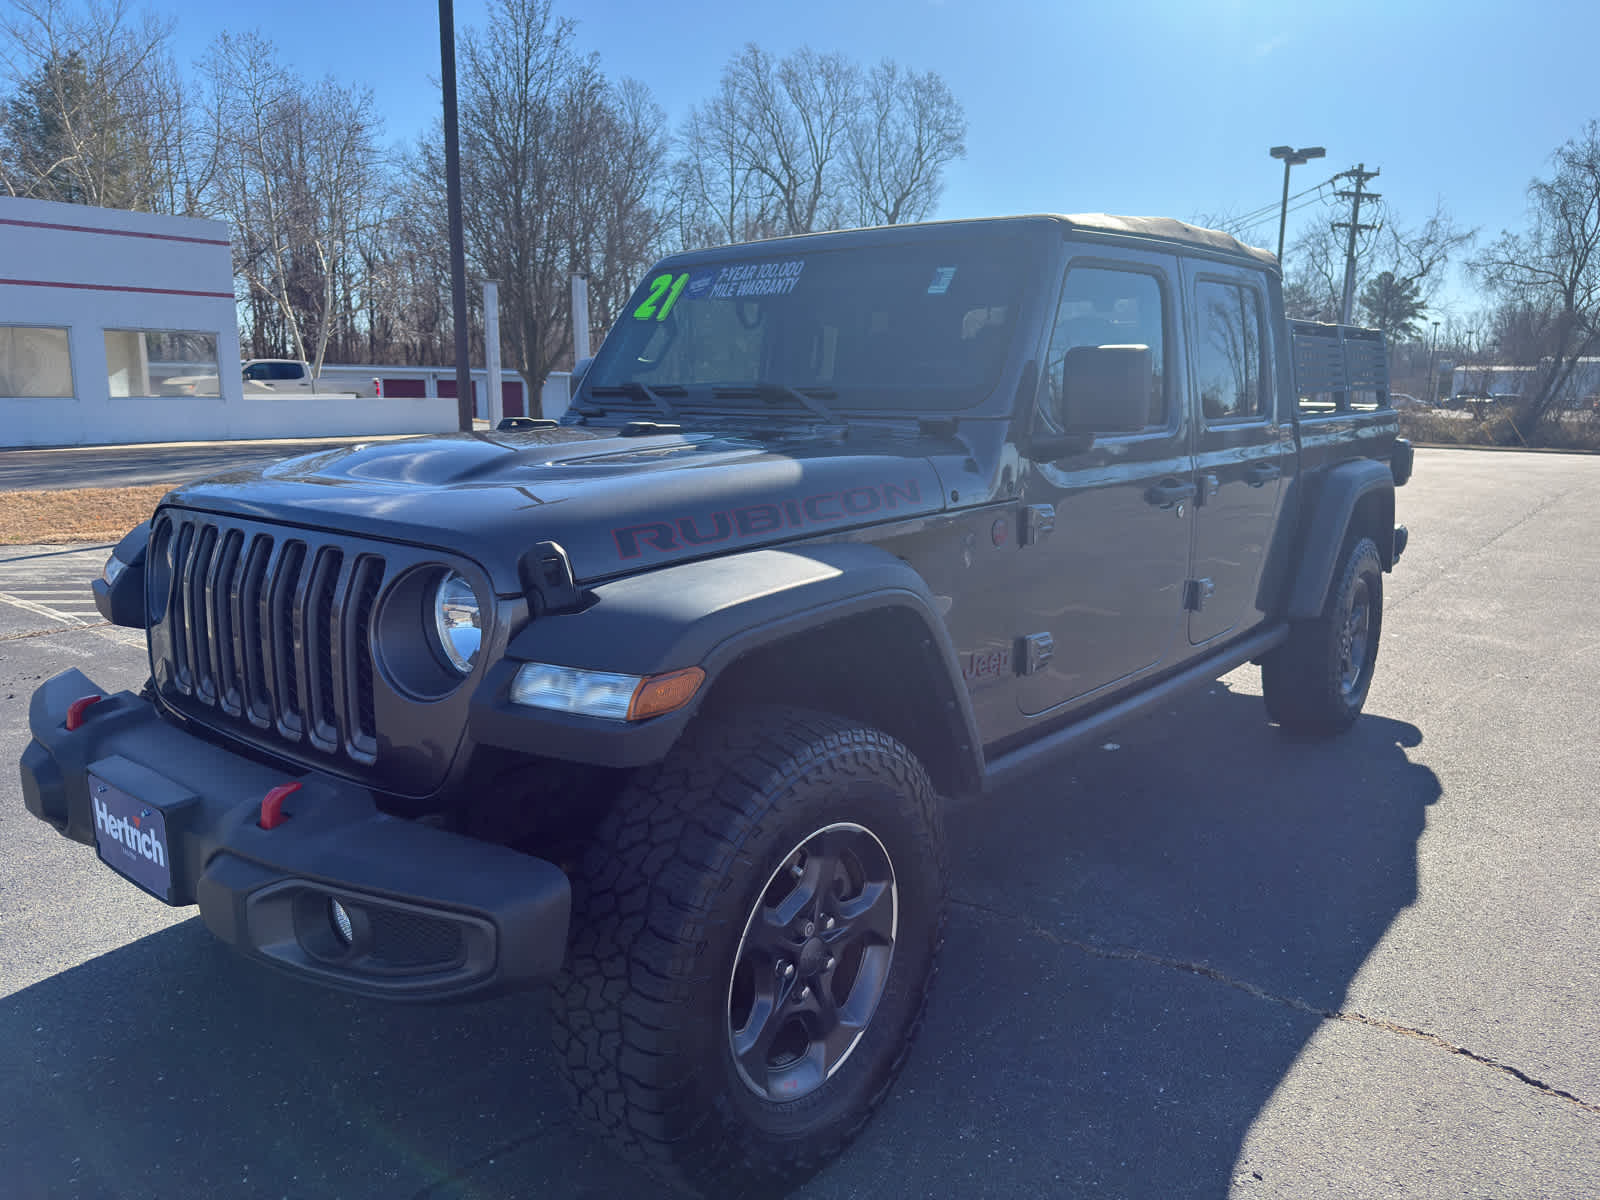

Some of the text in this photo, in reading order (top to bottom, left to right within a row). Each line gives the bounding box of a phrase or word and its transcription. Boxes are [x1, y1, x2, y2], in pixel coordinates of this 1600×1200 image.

[710, 281, 738, 297] MILE
[735, 276, 801, 297] WARRANTY
[717, 264, 758, 283] 7-YEAR
[633, 273, 690, 321] 21
[611, 479, 923, 561] RUBICON
[961, 649, 1008, 682] Jeep
[93, 797, 165, 868] Hertrich
